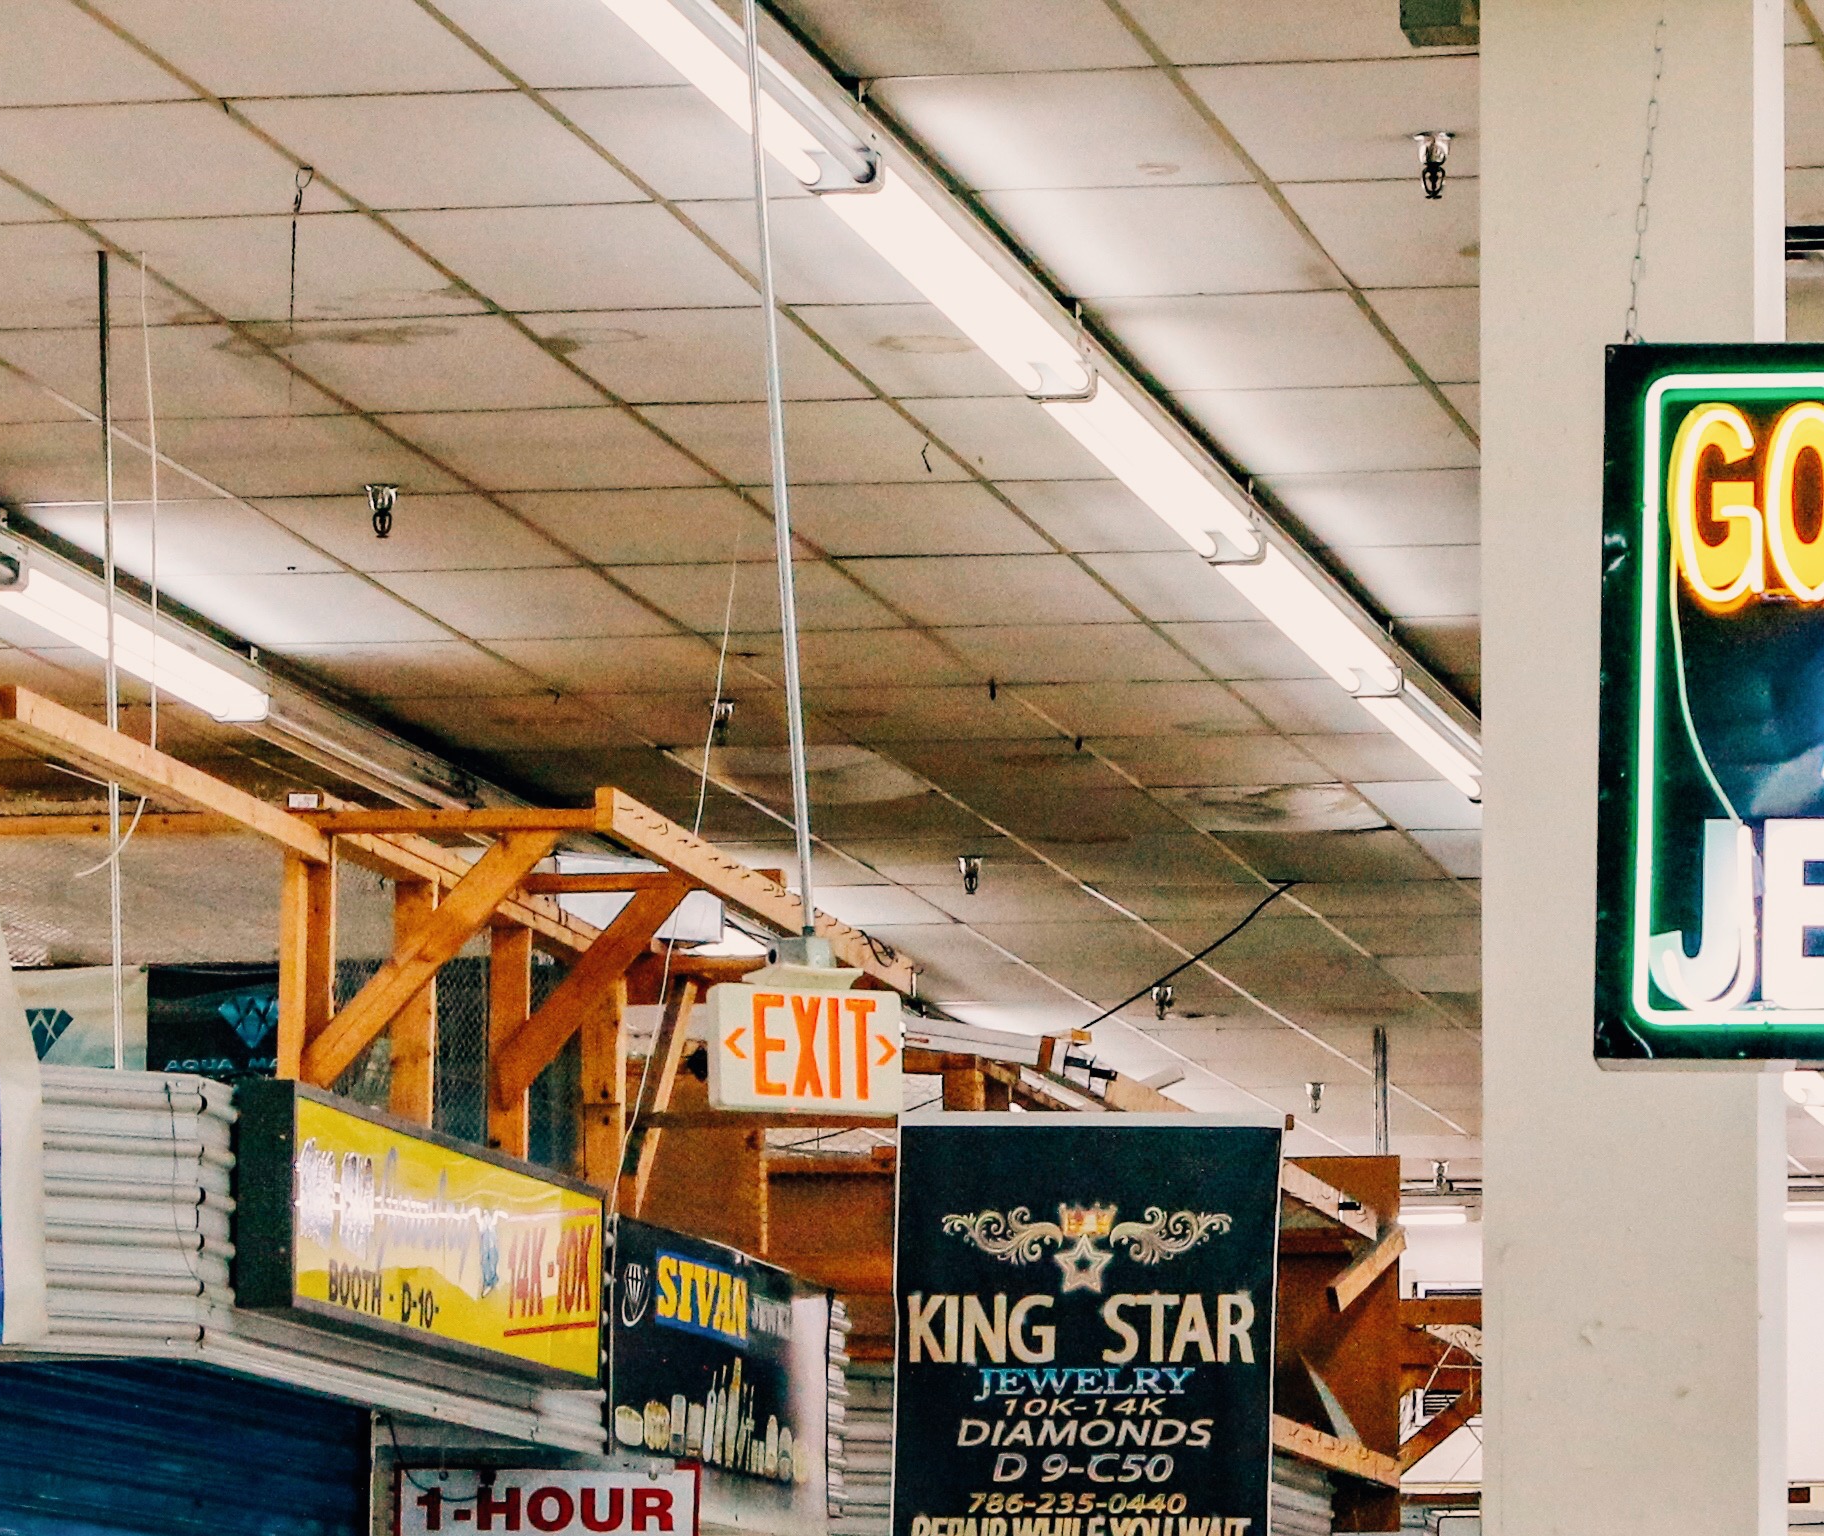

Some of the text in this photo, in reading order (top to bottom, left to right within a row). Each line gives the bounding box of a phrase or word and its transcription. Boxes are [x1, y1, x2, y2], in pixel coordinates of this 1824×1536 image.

[164, 1058, 233, 1072] AQUA
[752, 993, 876, 1100] EXIT
[328, 1258, 382, 1316] BOOTH
[508, 1227, 546, 1318] 14K
[556, 1223, 595, 1314] 10K
[657, 1255, 748, 1341] SIVAN
[907, 1293, 1255, 1364] KING STAR
[974, 1367, 1196, 1401] JEWELRY
[1005, 1398, 1168, 1417] 10K-14K
[957, 1418, 1214, 1448] DIAMONDS
[992, 1454, 1175, 1483] D 9-C50
[417, 1486, 674, 1533] 1-HOUR
[967, 1493, 1188, 1515] 786-235-0440
